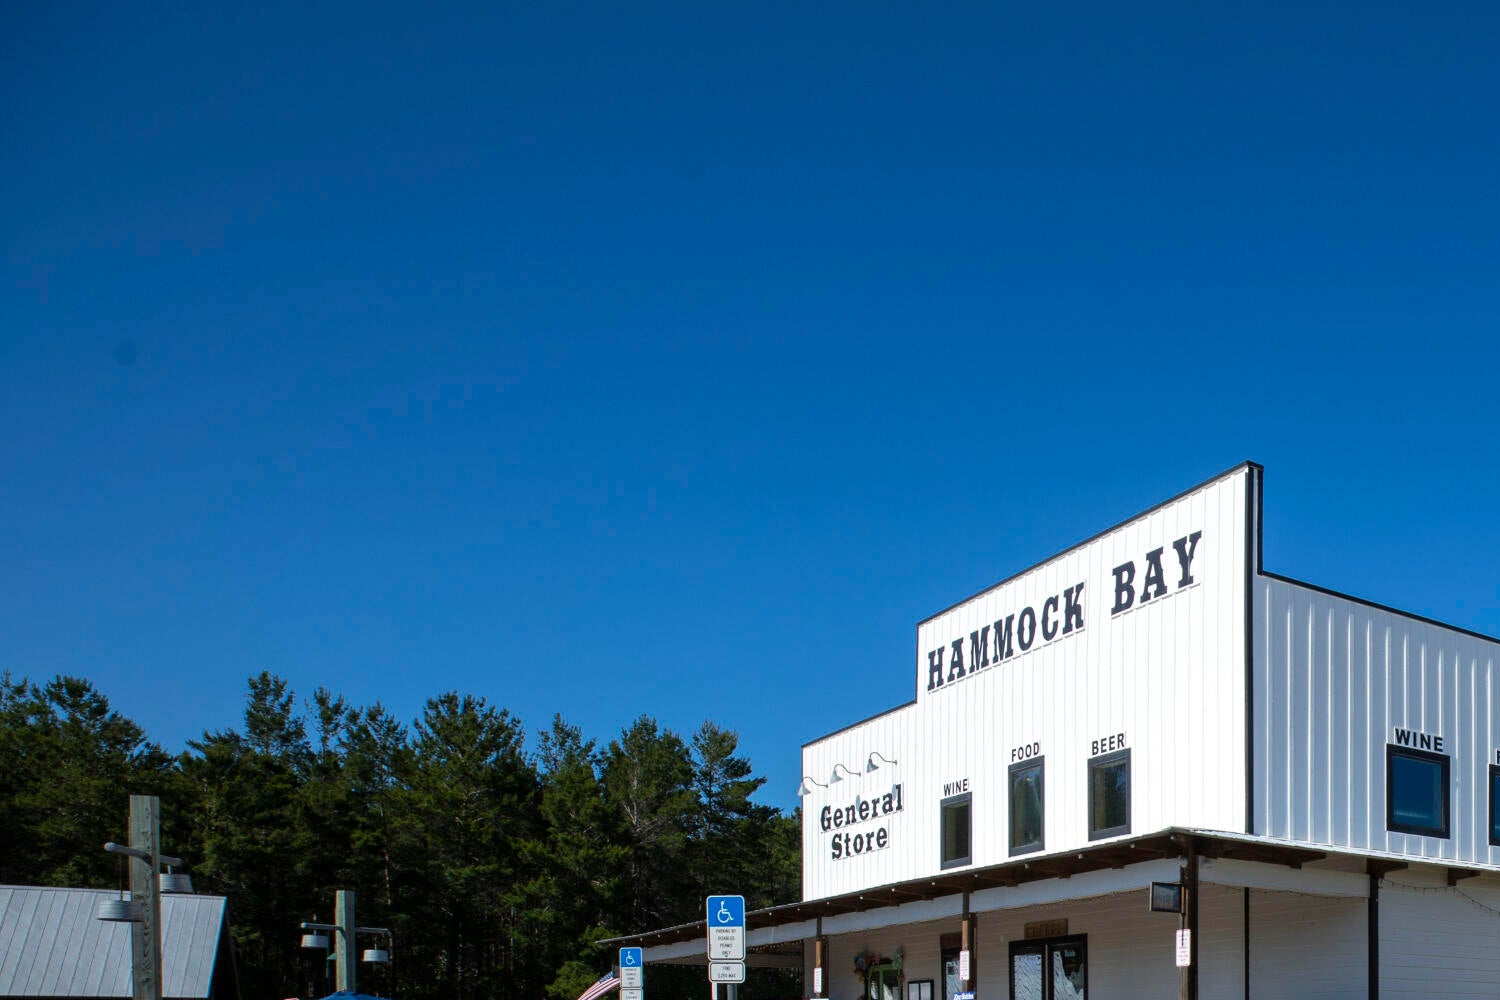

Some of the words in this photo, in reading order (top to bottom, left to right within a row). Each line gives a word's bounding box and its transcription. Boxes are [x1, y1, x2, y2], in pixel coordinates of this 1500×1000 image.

[927, 581, 1085, 691] HAMMOCK
[1110, 530, 1202, 615] BAY
[1011, 741, 1041, 761] FOOD
[1091, 732, 1126, 756] BEER
[1394, 728, 1444, 752] WINE
[943, 778, 969, 797] WINE
[820, 783, 904, 832] General
[831, 825, 888, 860] Store
